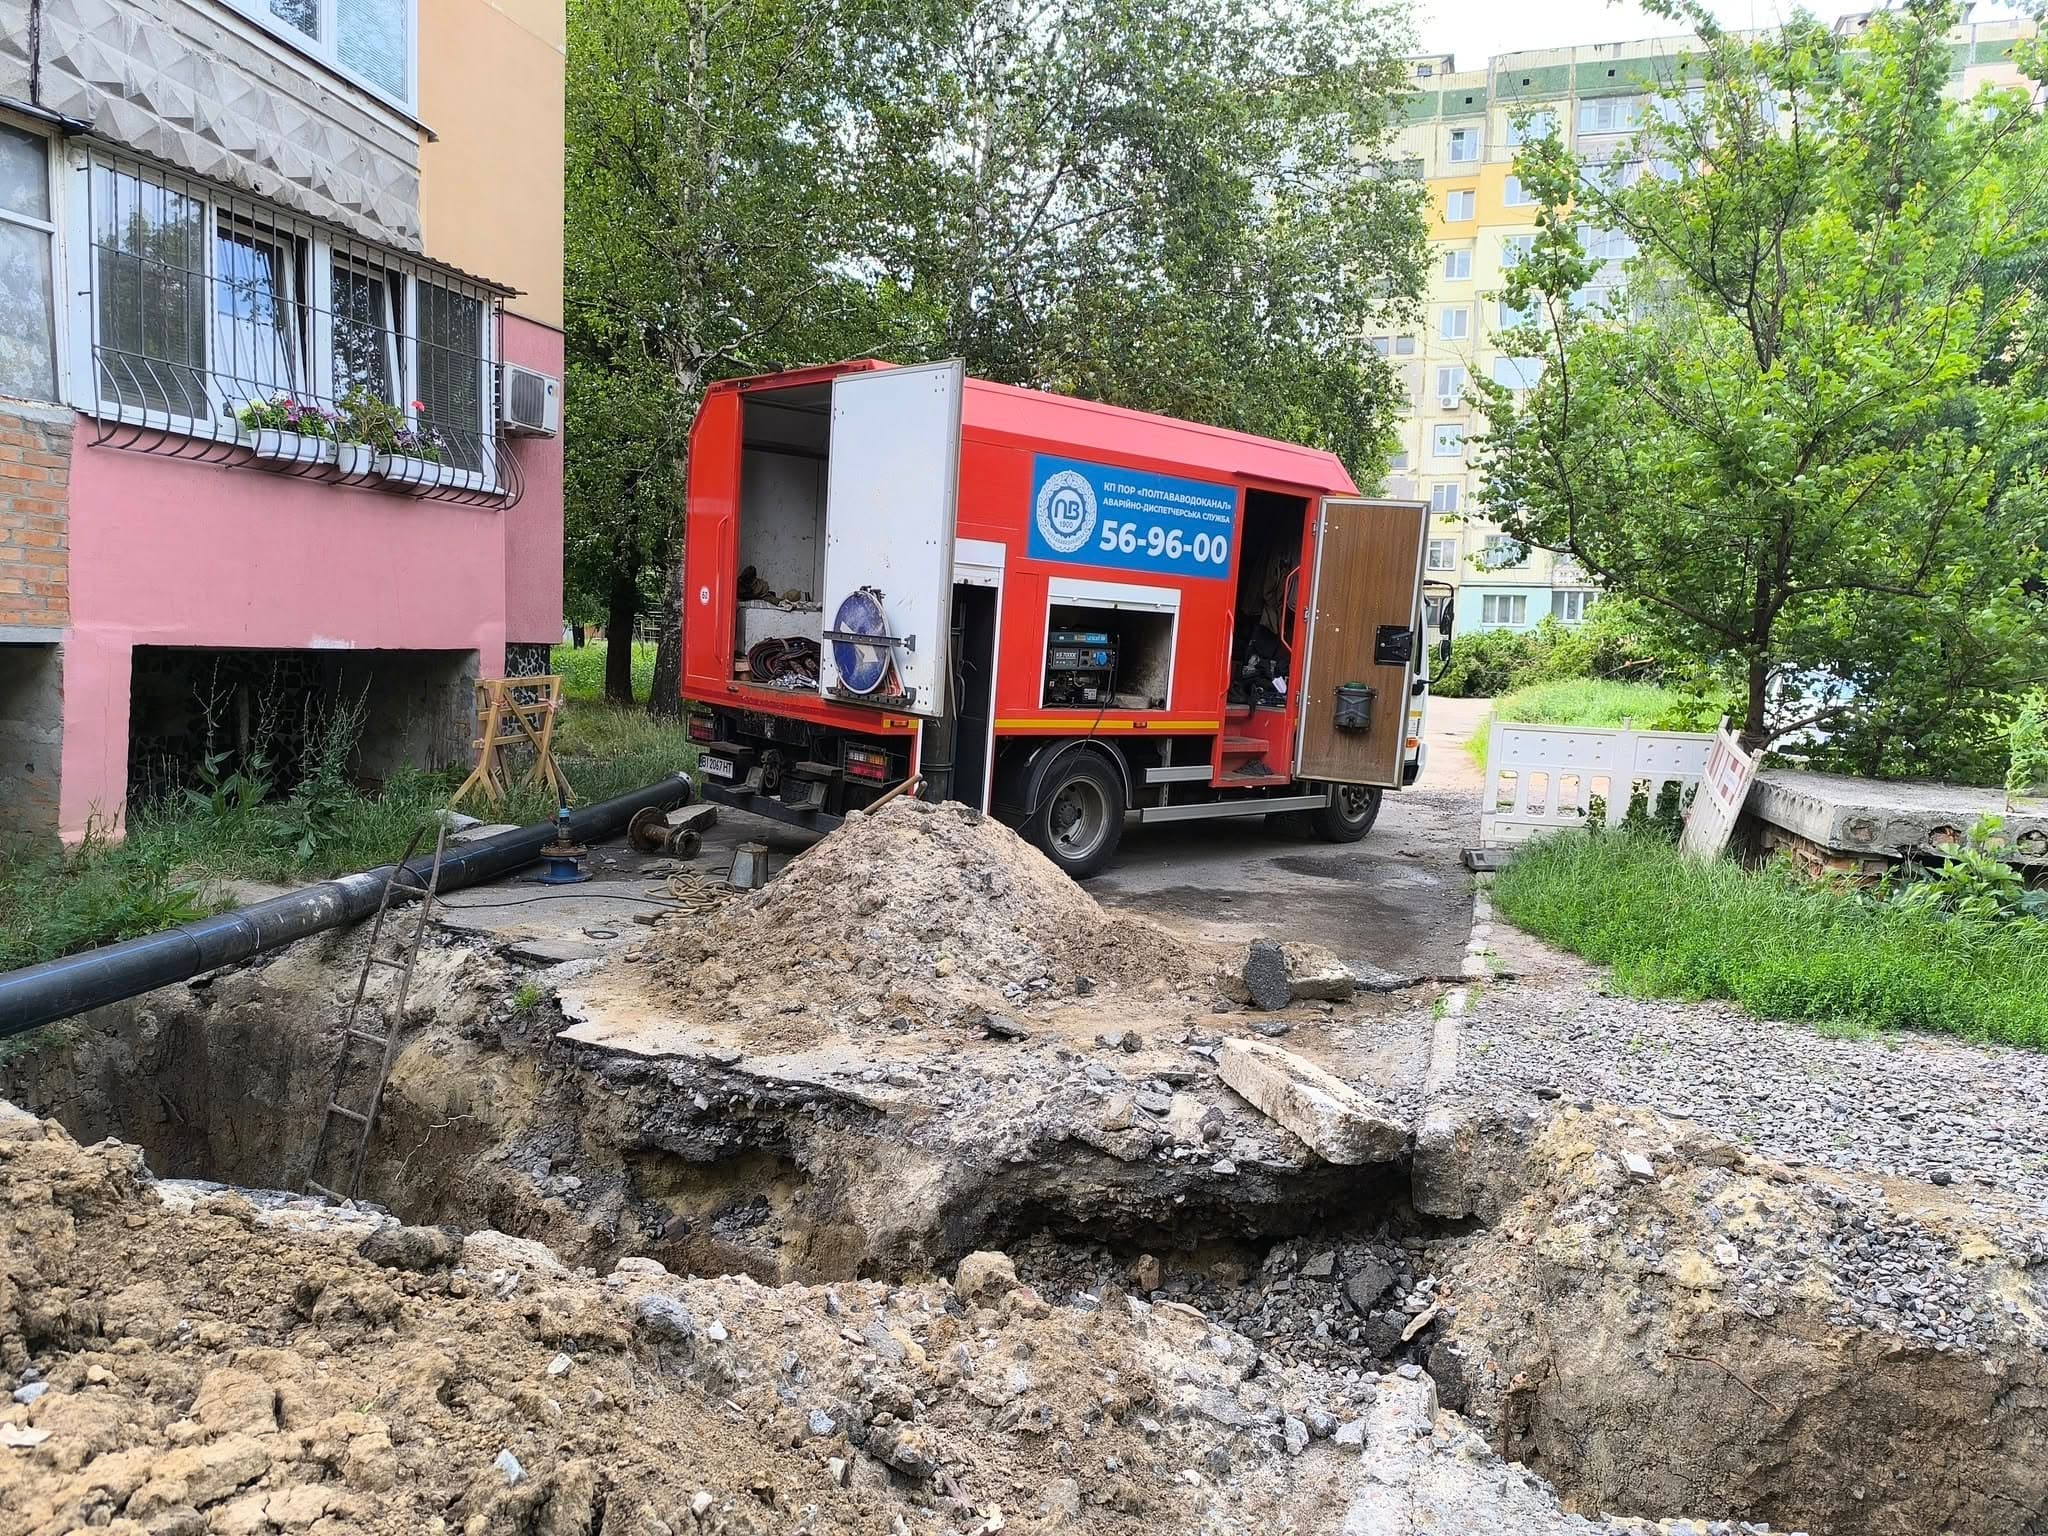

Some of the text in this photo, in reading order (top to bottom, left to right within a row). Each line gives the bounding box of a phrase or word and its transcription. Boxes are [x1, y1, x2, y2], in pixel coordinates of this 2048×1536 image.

[1103, 482, 1232, 510] КП ПОР «ПОЛТАВАВОДОКАНАЛ»
[1103, 497, 1231, 524] АВАРІЙНО-ДИСПЕТЧЕРСЬКА СЛУЖБА
[1100, 519, 1228, 565] 56-96-00
